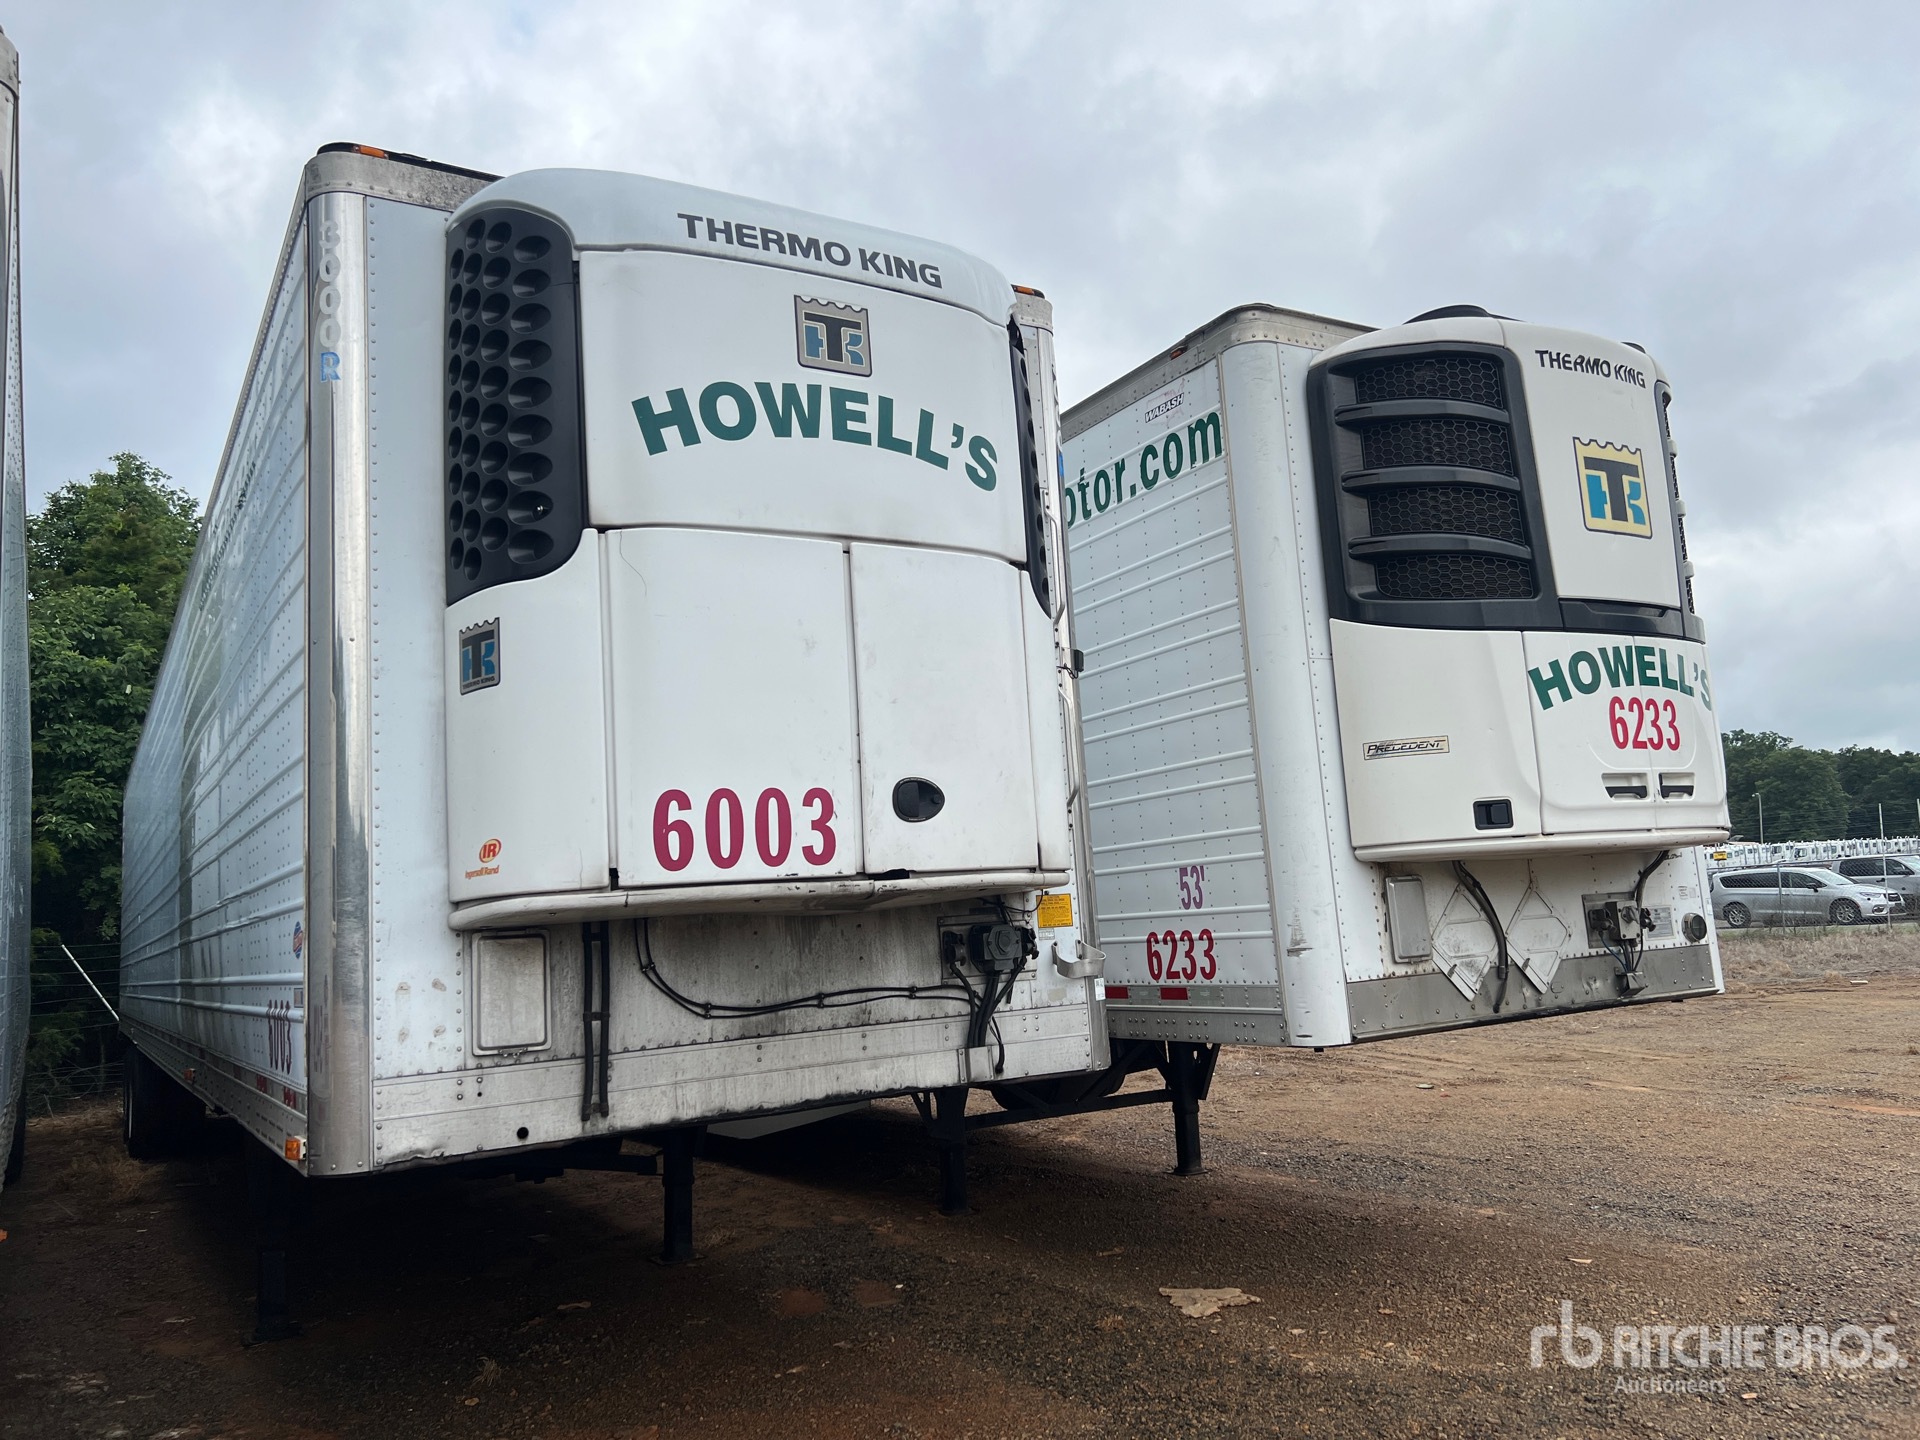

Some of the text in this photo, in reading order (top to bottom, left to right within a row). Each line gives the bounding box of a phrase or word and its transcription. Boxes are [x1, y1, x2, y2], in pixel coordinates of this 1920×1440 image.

[677, 212, 943, 289] THERMO KING
[1535, 349, 1646, 389] THERMO KING
[1144, 392, 1184, 424] WABASH
[631, 380, 998, 492] HOWELL'S
[1527, 645, 1712, 711] HOWELL'S
[1608, 696, 1680, 751] 6233
[482, 843, 497, 859] IR
[652, 787, 837, 872] 6003
[1146, 928, 1217, 981] 6233
